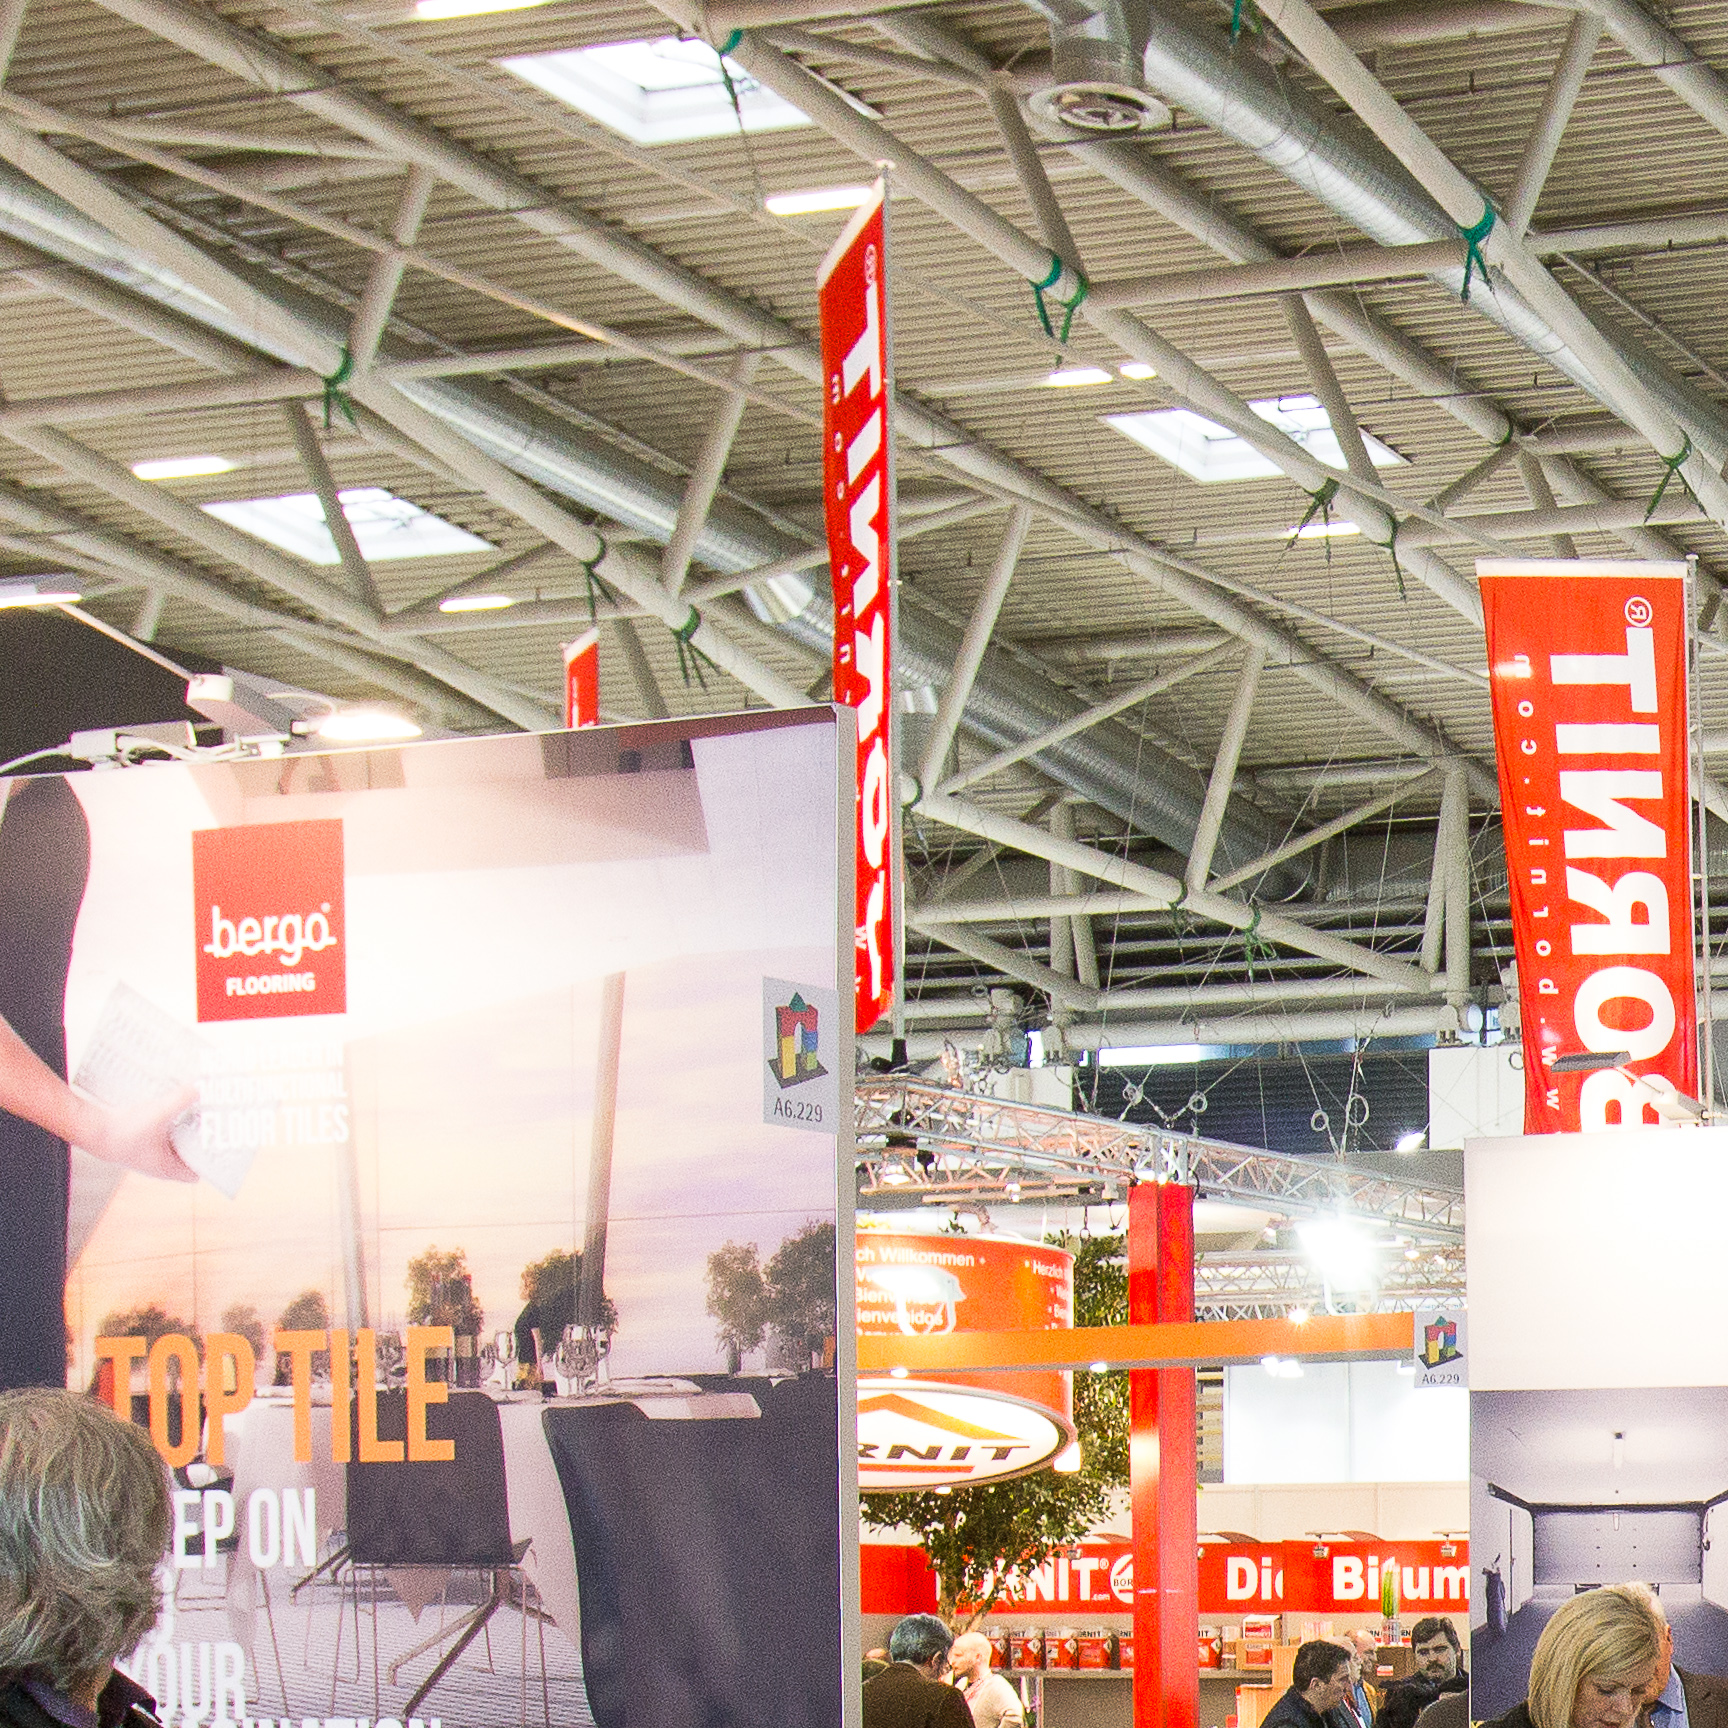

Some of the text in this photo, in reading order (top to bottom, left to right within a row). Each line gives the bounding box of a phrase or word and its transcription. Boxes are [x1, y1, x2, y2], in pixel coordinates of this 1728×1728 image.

[203, 905, 337, 966] bergo
[226, 972, 316, 996] FLOORING
[200, 1104, 349, 1151] FLOOR TILES
[774, 1098, 823, 1123] A6.229
[881, 1248, 975, 1267] Willkommen
[1422, 1373, 1460, 1385] A6.229
[96, 1326, 455, 1468] TOP TILE
[858, 1443, 1030, 1461] RNIT
[173, 1487, 317, 1569] EP ON
[1226, 1555, 1284, 1601] Di
